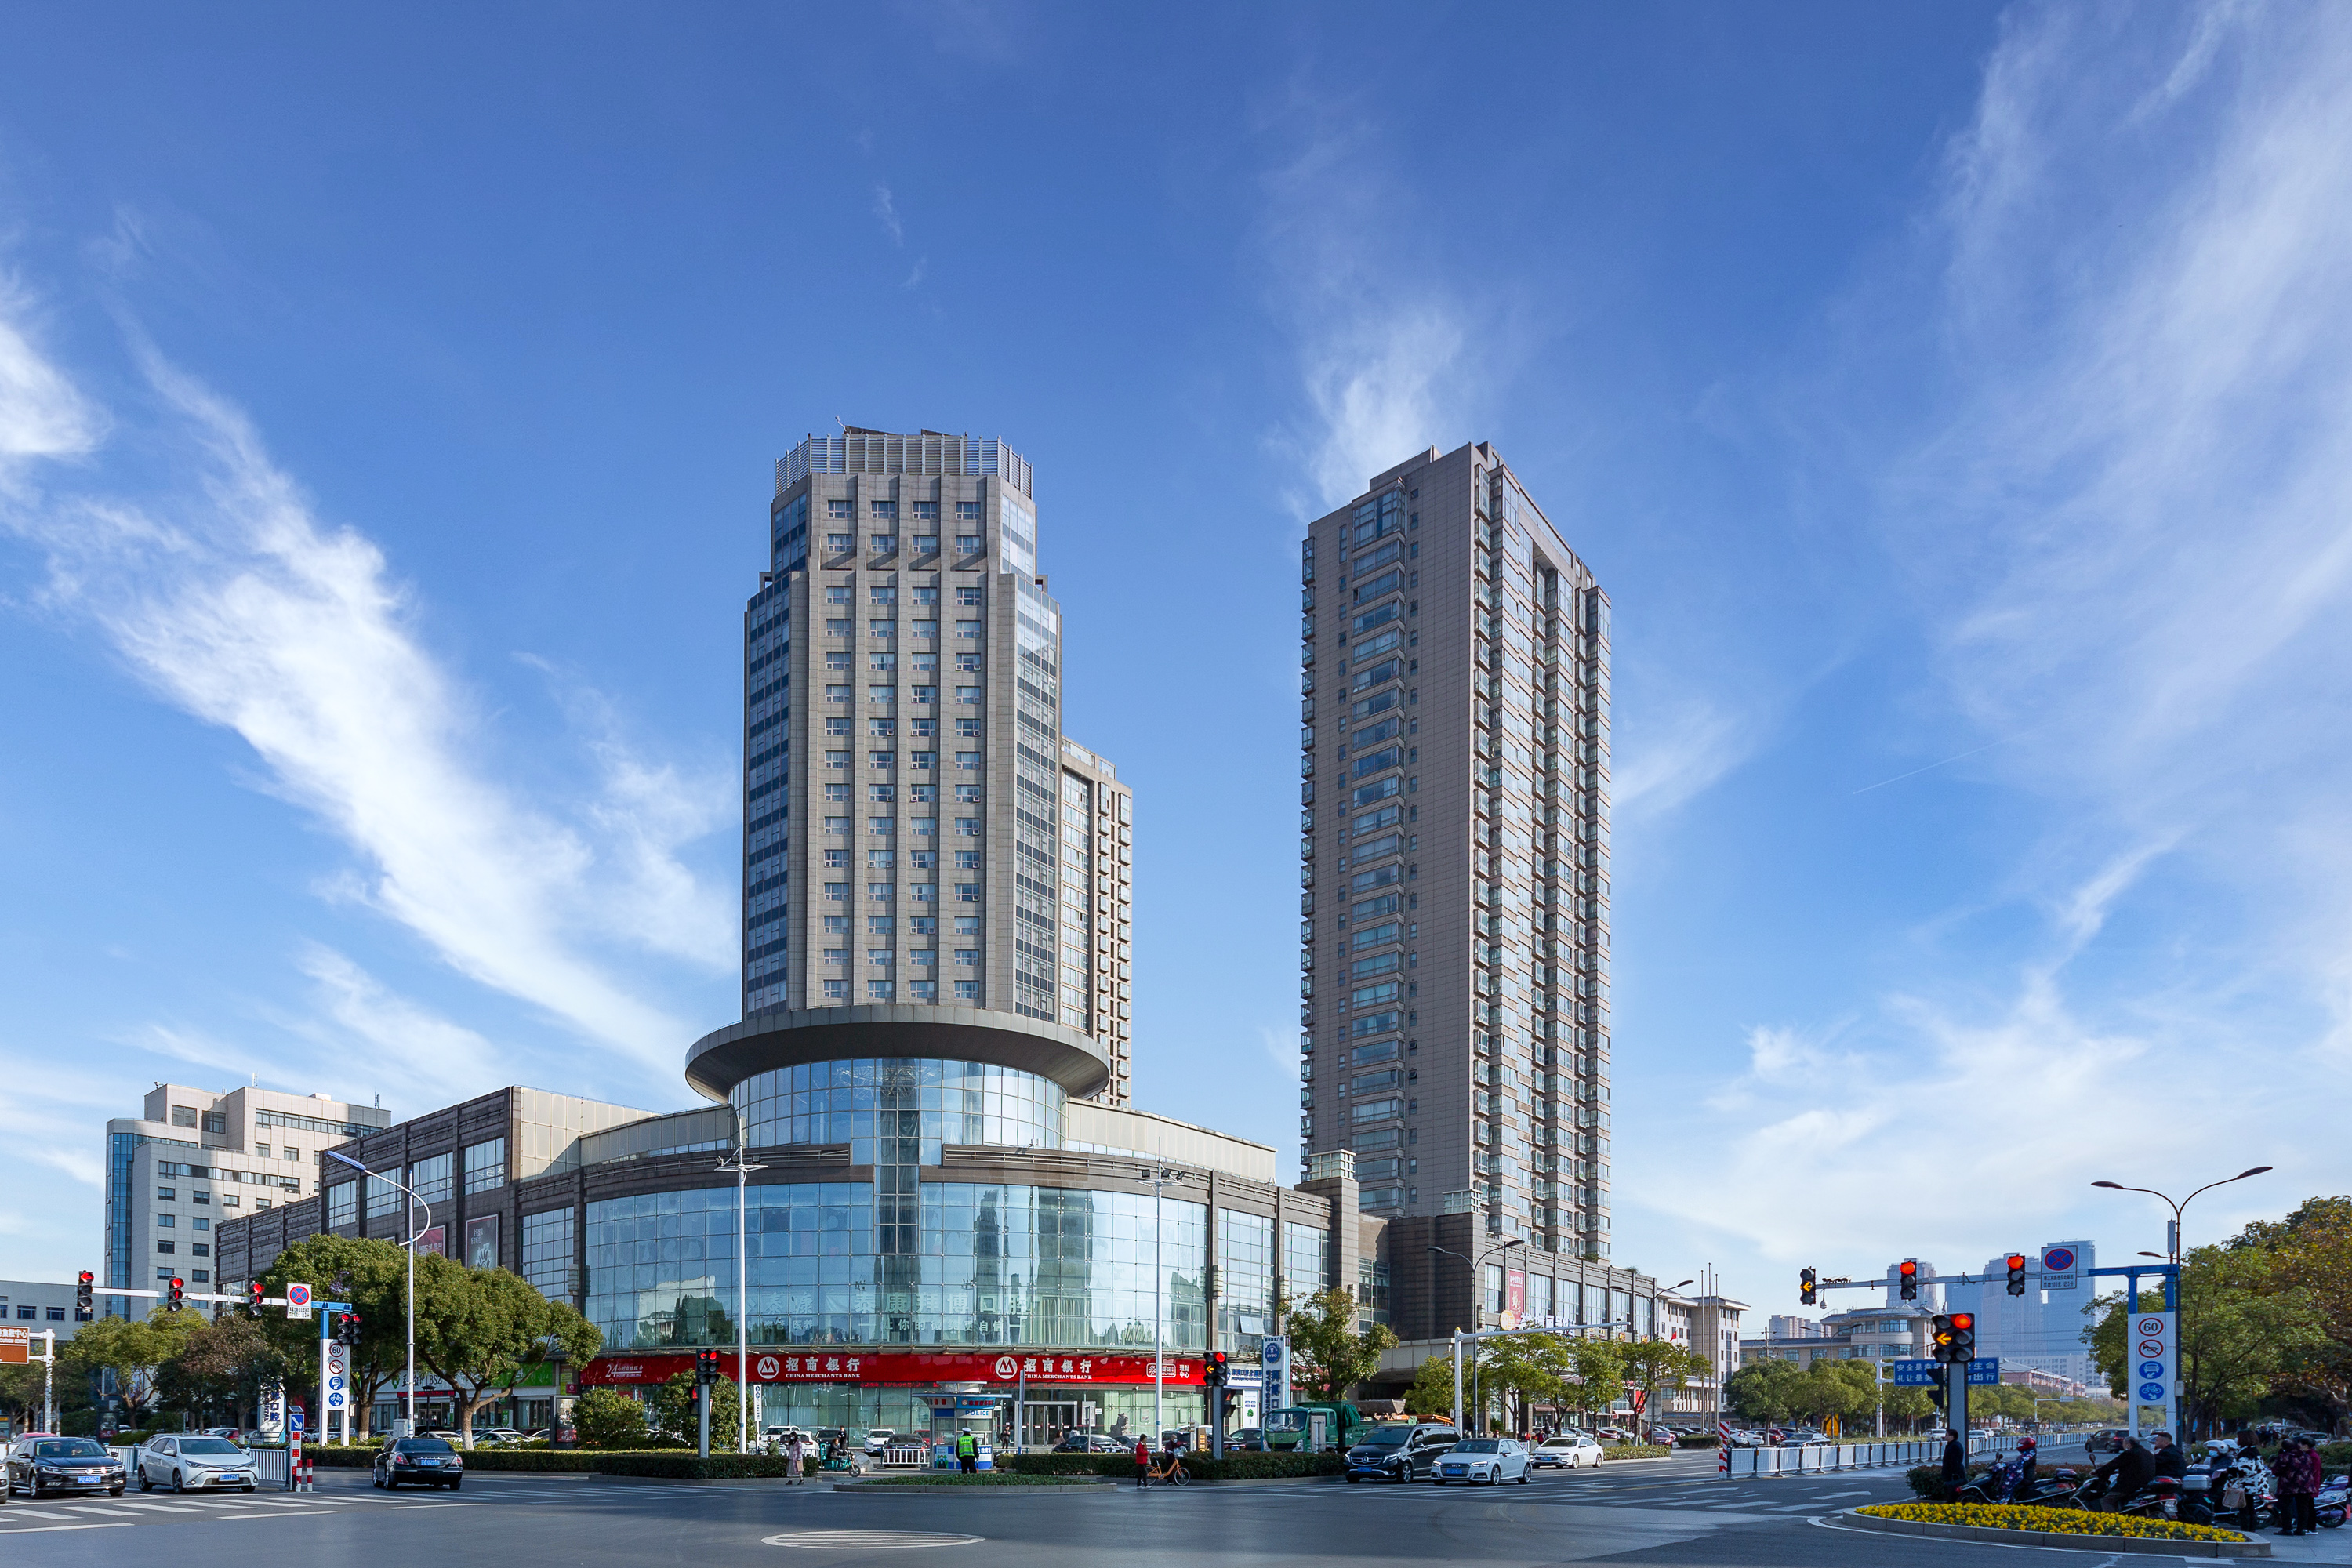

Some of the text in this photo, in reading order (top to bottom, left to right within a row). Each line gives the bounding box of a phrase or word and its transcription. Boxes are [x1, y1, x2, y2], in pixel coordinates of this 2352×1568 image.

[854, 1293, 1029, 1315] 泰康拜博口腔
[2143, 1323, 2158, 1331] 60
[605, 1364, 619, 1377] 24
[786, 1357, 860, 1372] 招商银行
[1023, 1357, 1092, 1373] 招商银行
